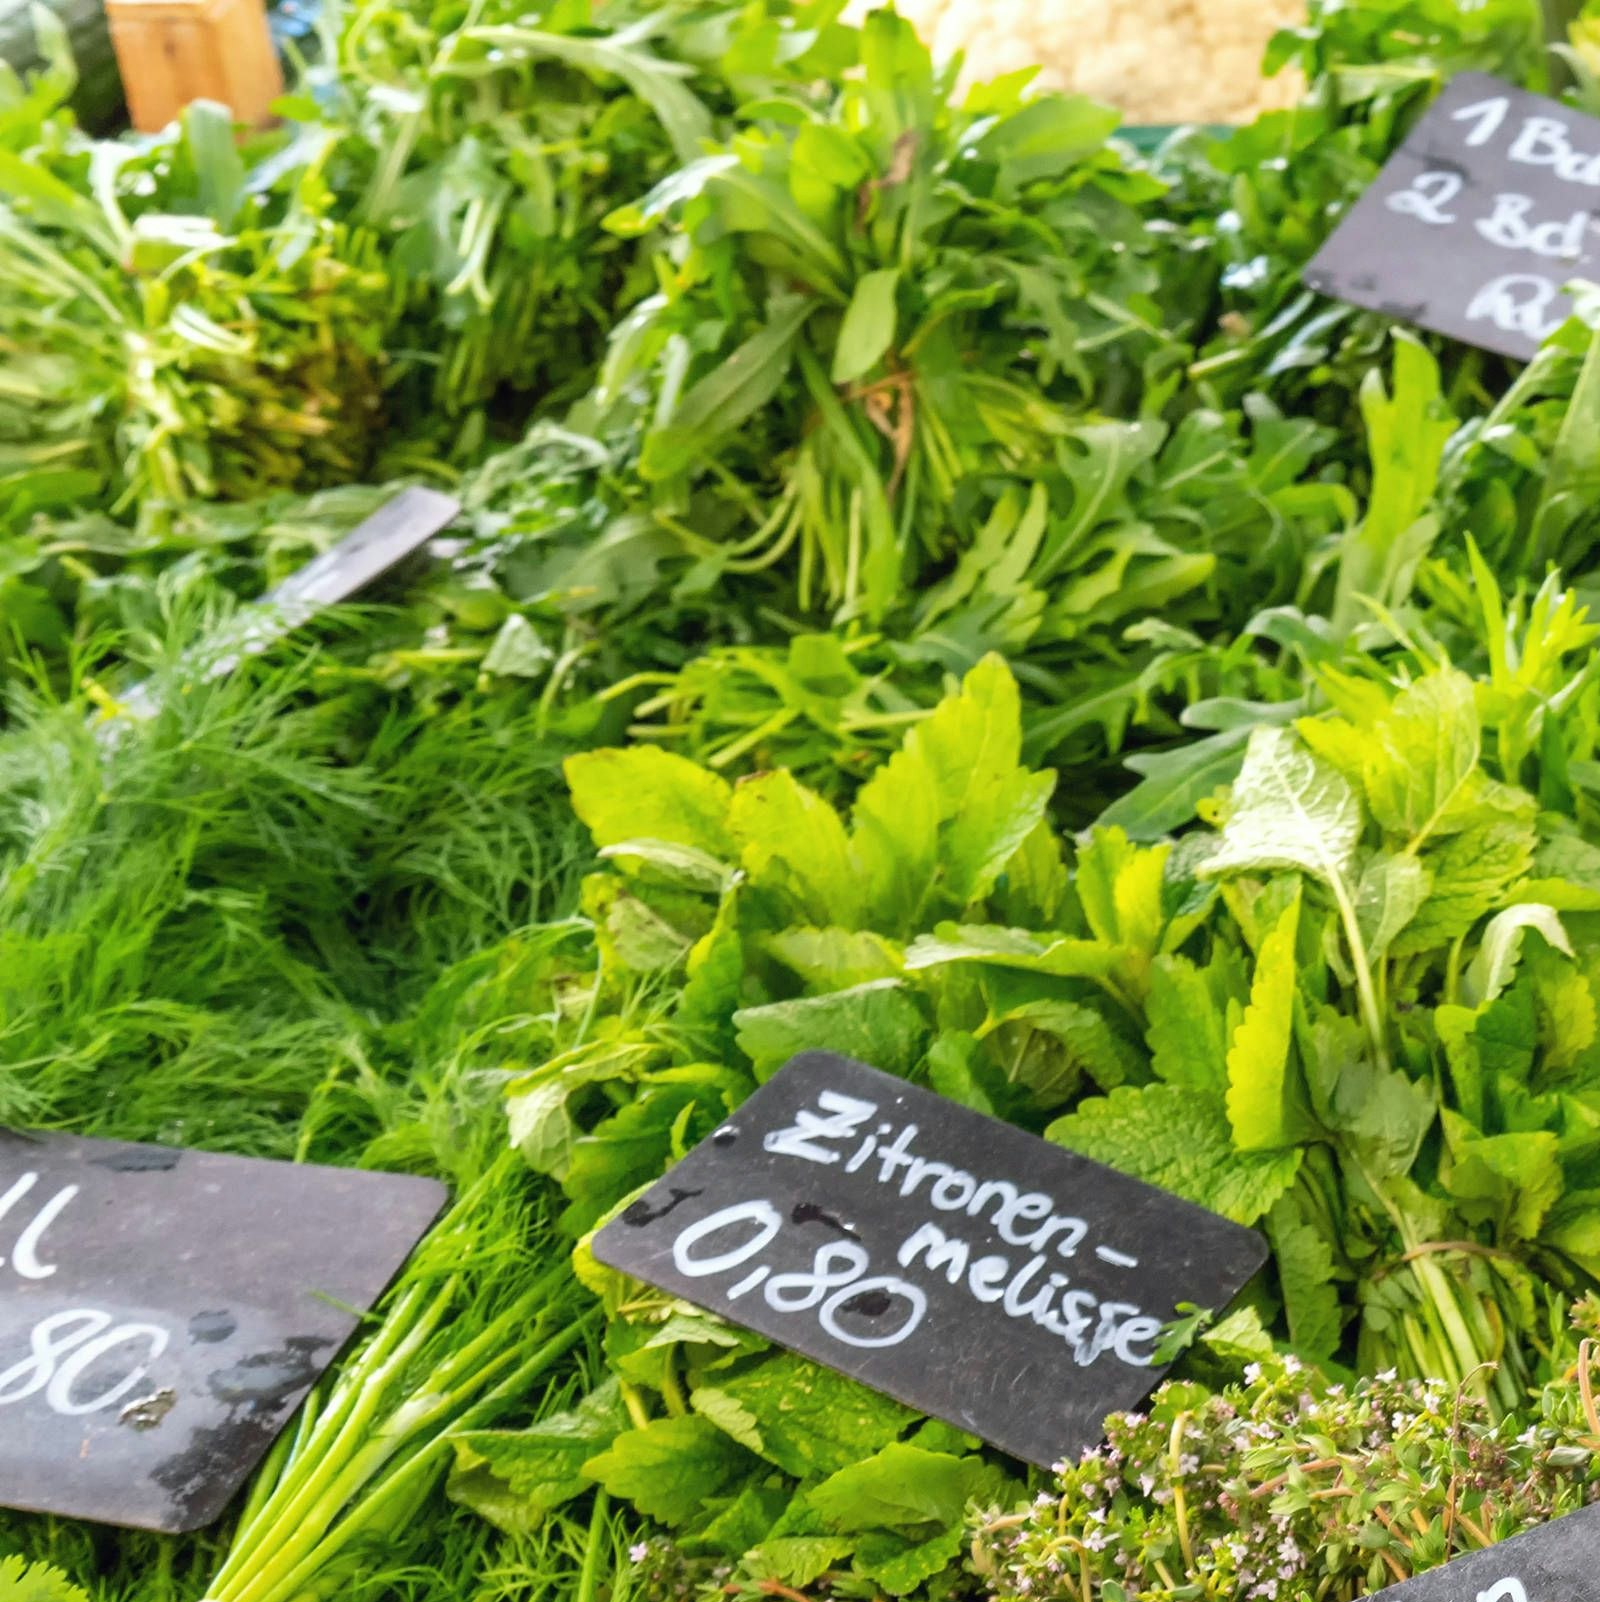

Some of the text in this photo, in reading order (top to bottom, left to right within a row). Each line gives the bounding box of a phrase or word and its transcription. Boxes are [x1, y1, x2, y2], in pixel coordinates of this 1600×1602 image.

[1448, 96, 1512, 148] 1
[1386, 172, 1463, 225] 2
[672, 1199, 928, 1350] 0,80
